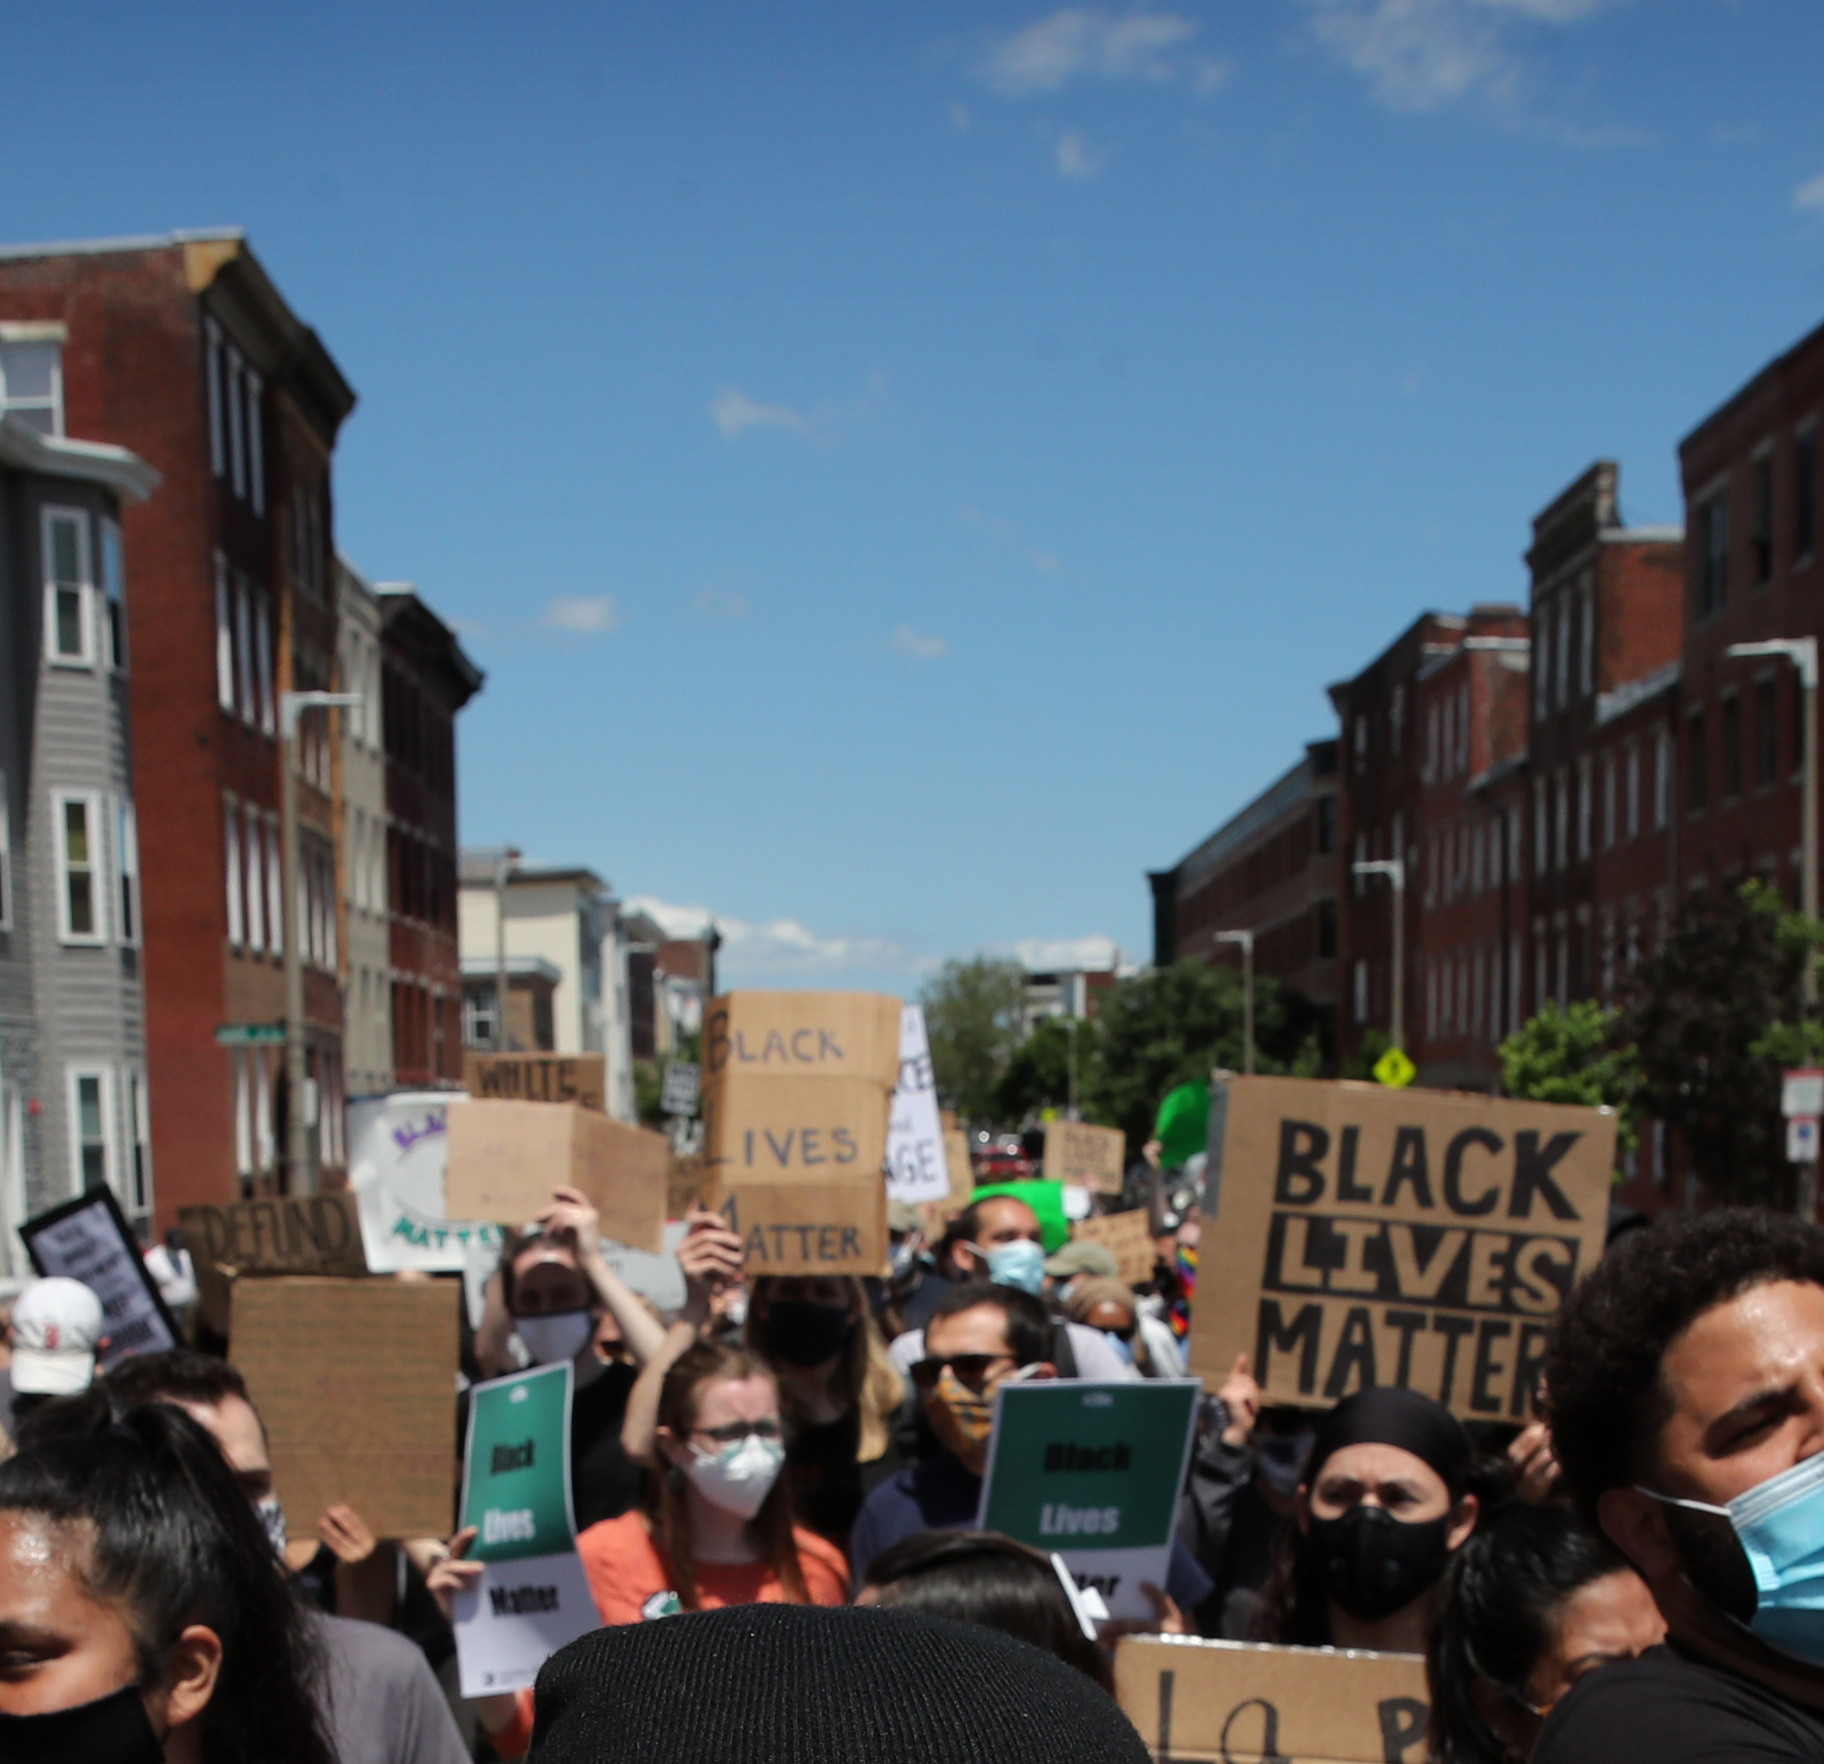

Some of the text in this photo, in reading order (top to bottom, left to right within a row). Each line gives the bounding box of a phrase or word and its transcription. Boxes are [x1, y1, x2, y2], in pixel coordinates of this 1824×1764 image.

[707, 1008, 847, 1074] BLACK
[394, 1107, 446, 1149] BLA
[703, 1097, 861, 1168] LIVES
[1276, 1117, 1586, 1222] BLACK
[1277, 1216, 1574, 1315] LIVES
[1254, 1296, 1553, 1418] MATTER
[490, 1436, 536, 1476] Black
[1044, 1442, 1131, 1473] Black
[483, 1508, 536, 1546] Lives
[1039, 1503, 1120, 1536] Lives
[490, 1585, 560, 1618] Matter
